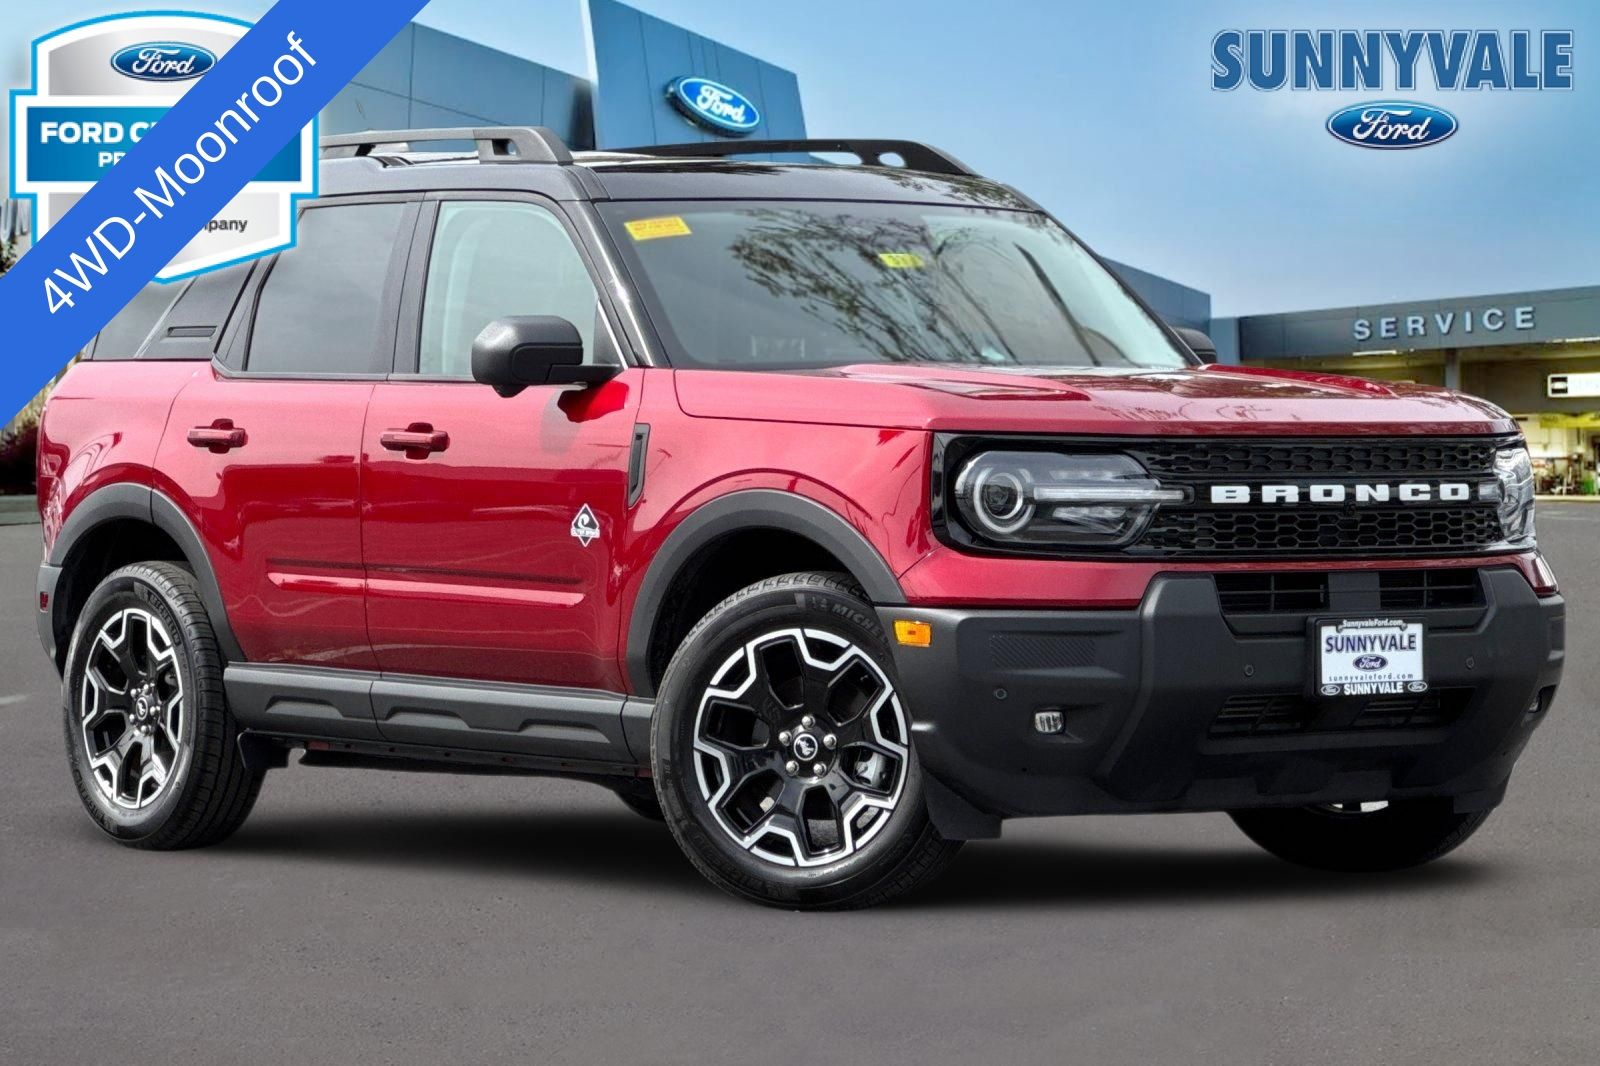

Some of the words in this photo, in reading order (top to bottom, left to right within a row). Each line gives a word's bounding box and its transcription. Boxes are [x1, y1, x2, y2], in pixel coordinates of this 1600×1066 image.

[696, 84, 746, 123] Ford
[1353, 306, 1535, 340] SERVICE
[1211, 484, 1470, 503] BRONCO
[1343, 619, 1404, 629] SunnyvaleFord.com
[1325, 633, 1417, 653] SUNNYVALE
[1358, 656, 1381, 668] Ford
[1329, 673, 1414, 682] sunnyvaleford.com
[1344, 682, 1404, 695] SUNNYVALE
